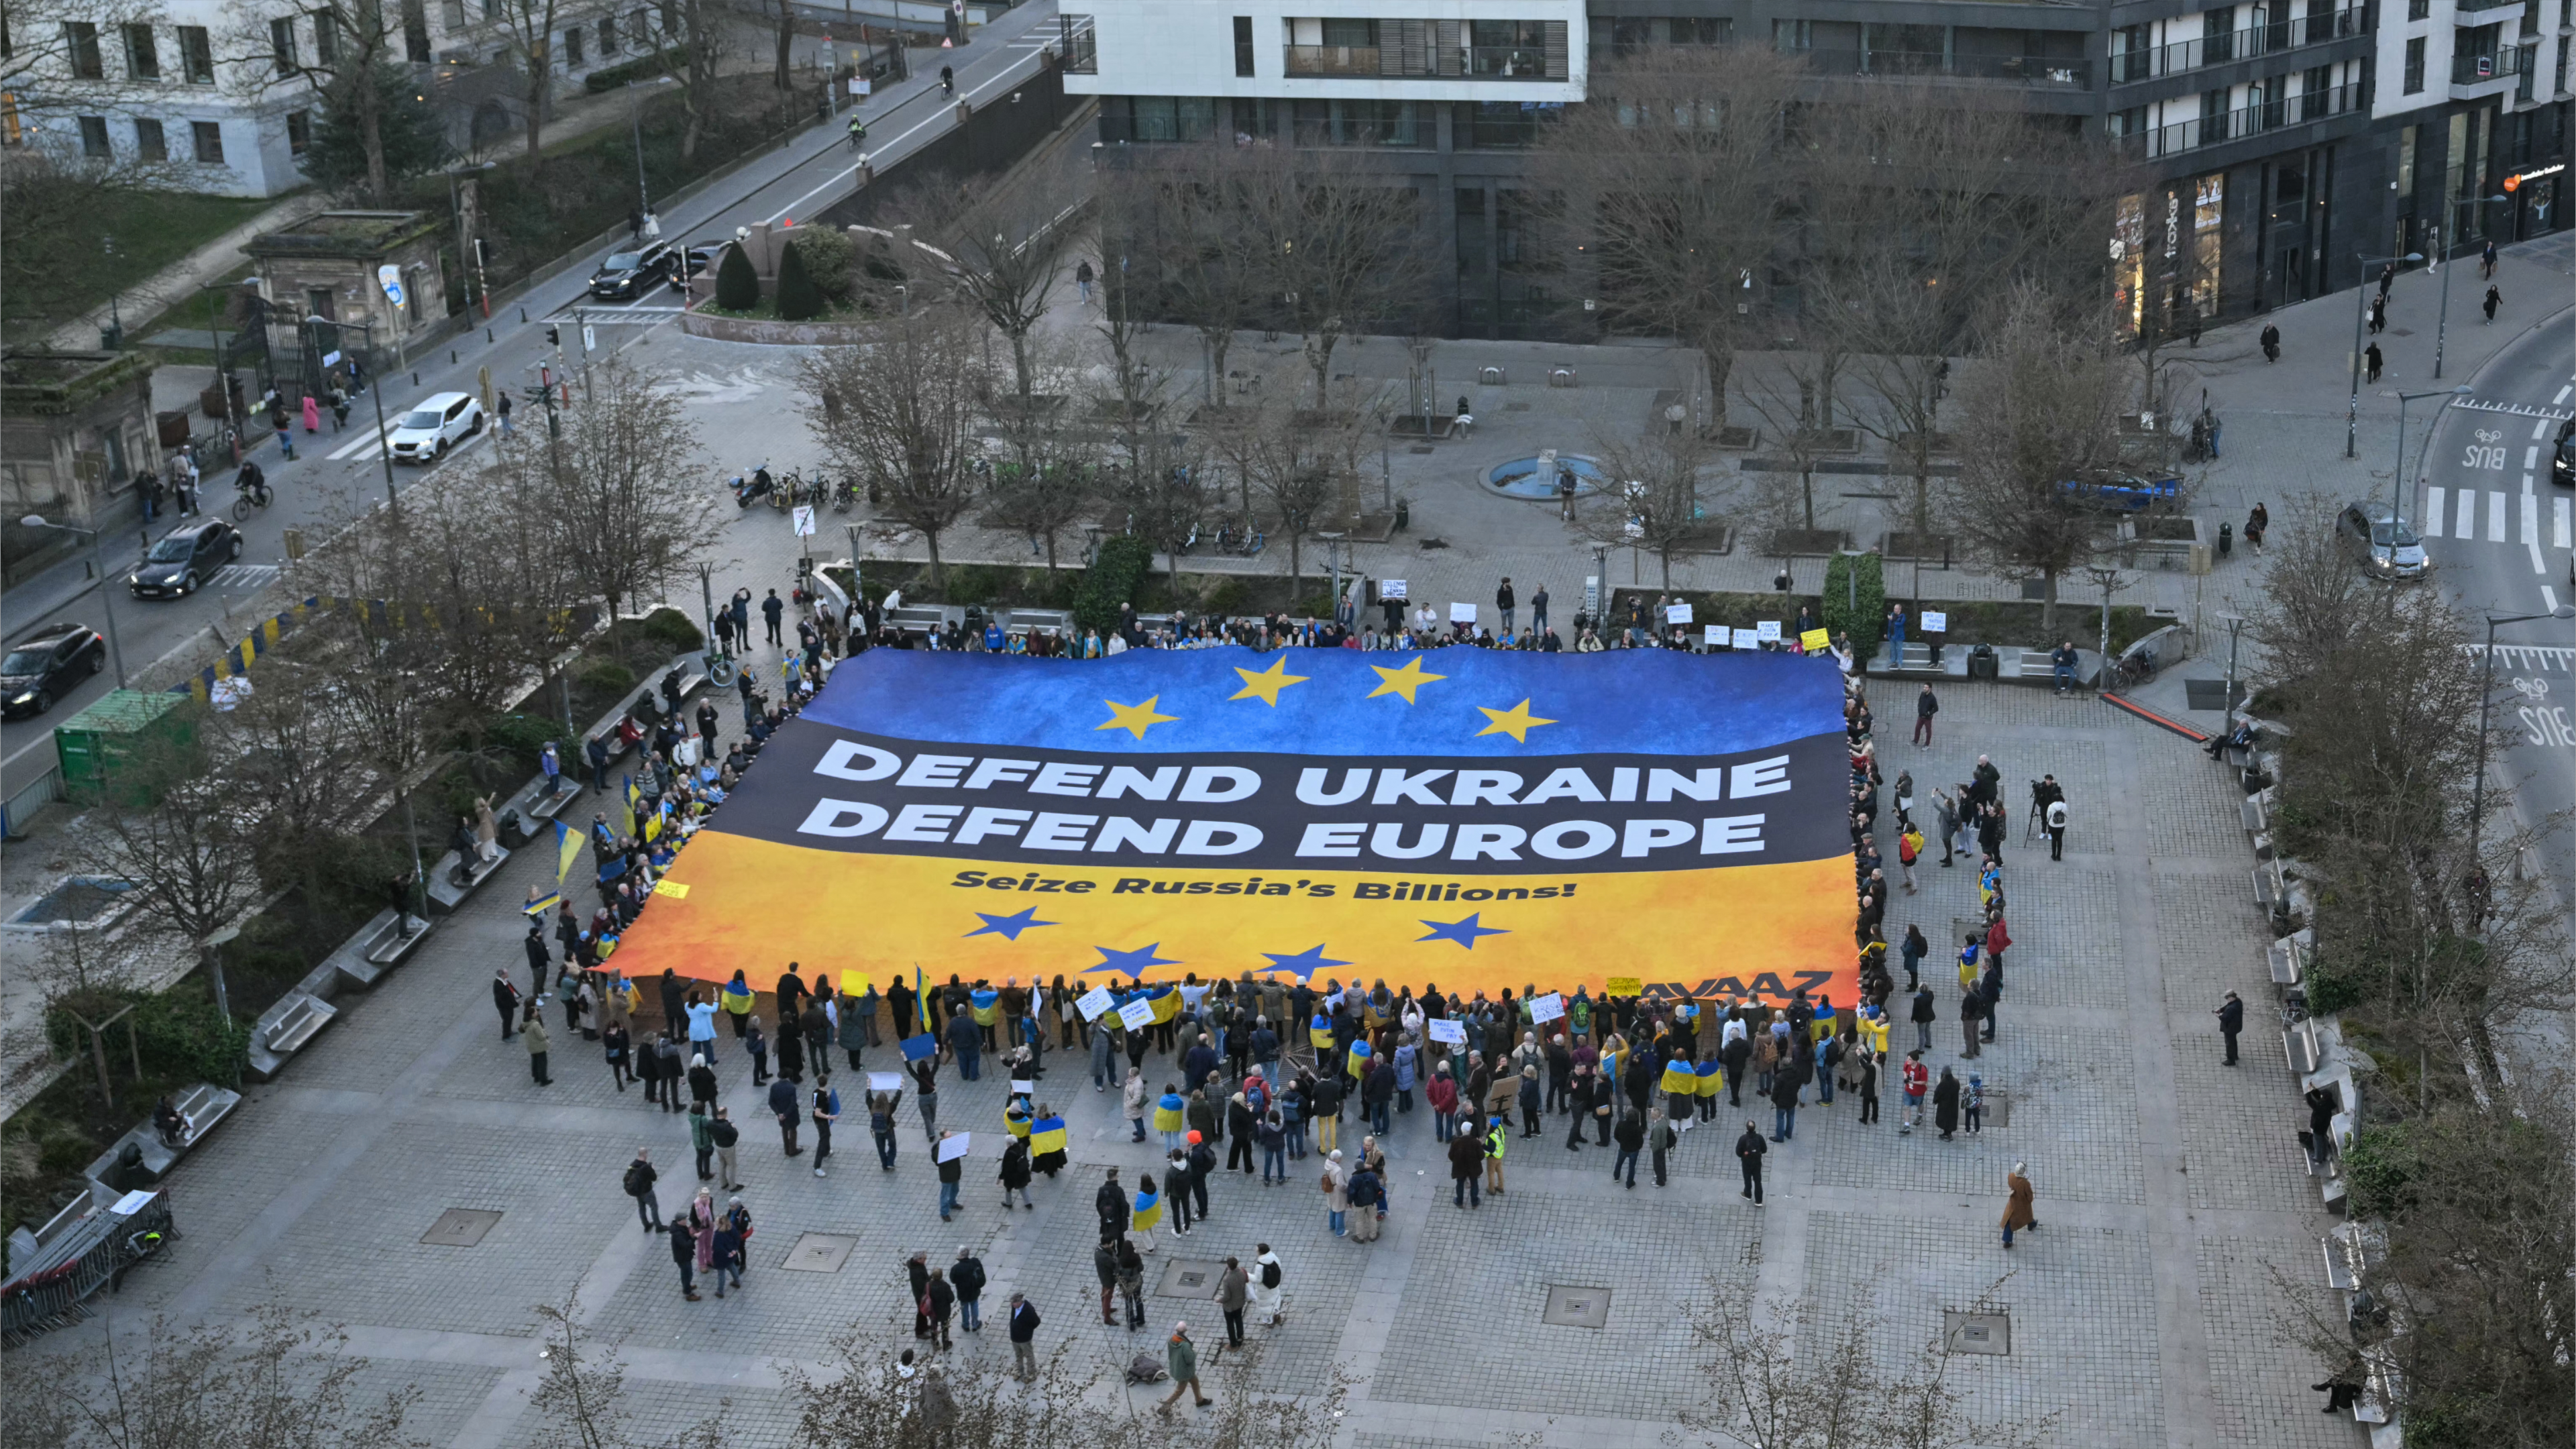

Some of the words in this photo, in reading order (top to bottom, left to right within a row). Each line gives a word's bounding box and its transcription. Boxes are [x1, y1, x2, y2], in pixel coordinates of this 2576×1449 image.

[2462, 445, 2506, 470] BUS
[2519, 706, 2575, 746] BUS
[812, 739, 1261, 802] DEFEND
[1295, 755, 1790, 805] UKRAINE
[796, 798, 1264, 855] DEFEND
[1295, 814, 1765, 860] EUROPE
[951, 871, 1097, 894] Seize
[1353, 882, 1577, 902] Billions!
[1534, 994, 1560, 1005] AGENT
[1638, 971, 1833, 1000] AVAAZ
